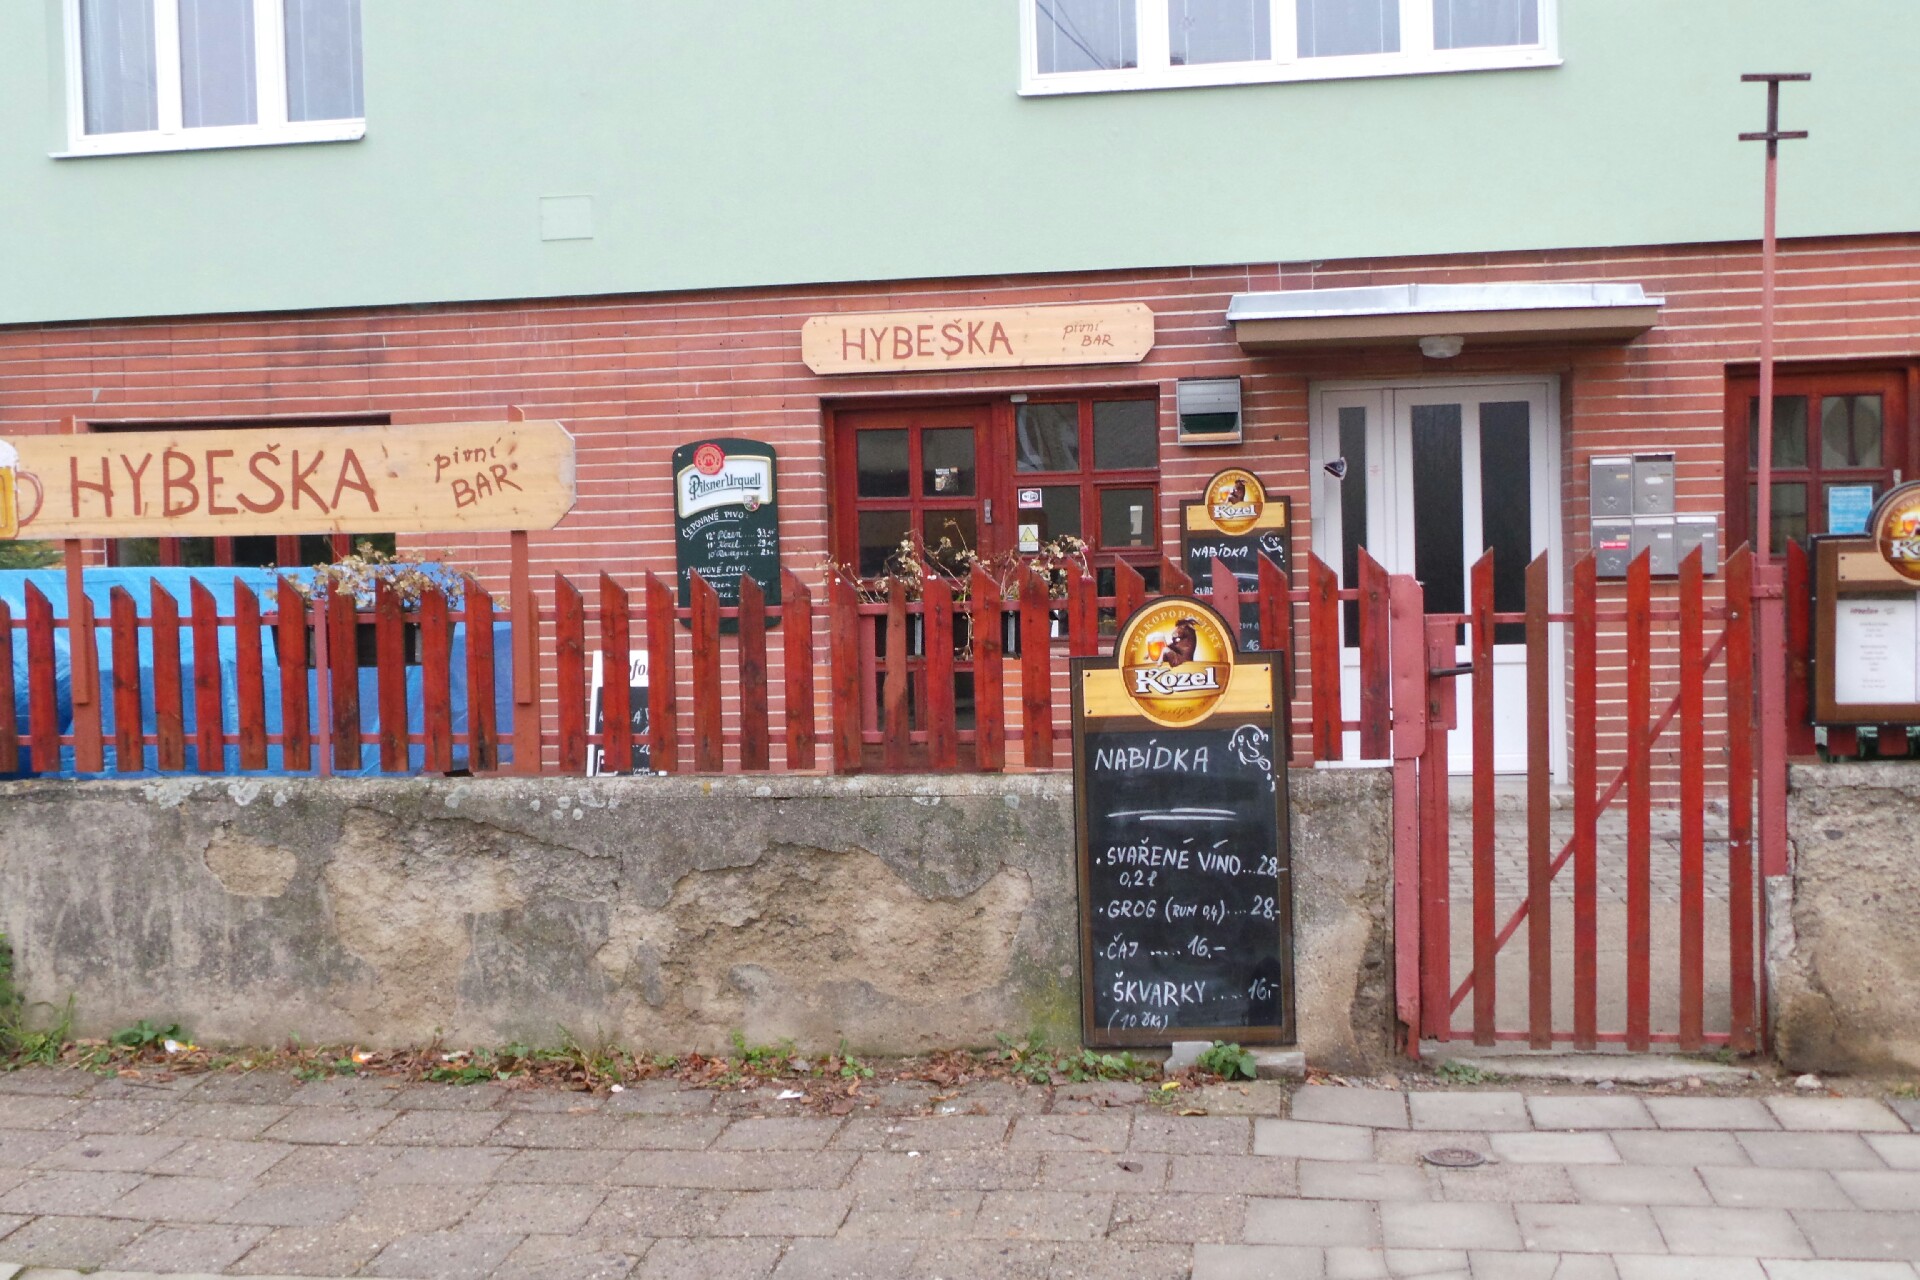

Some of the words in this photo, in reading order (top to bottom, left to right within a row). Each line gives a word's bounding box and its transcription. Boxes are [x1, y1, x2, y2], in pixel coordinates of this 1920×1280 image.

[842, 318, 1015, 361] HYBEŠKA
[1062, 319, 1104, 340] pivní
[1080, 334, 1115, 347] BAR
[433, 437, 502, 483] pivní
[69, 443, 379, 518] HYBEŠKA
[450, 464, 523, 508] BAR
[688, 474, 726, 501] Pilsner
[725, 472, 762, 491] Urquell
[1213, 504, 1258, 519] Kozel
[1192, 543, 1249, 558] NABÍDKA
[1135, 667, 1219, 694] Kozel
[1094, 739, 1209, 773] NABÍDKA
[1107, 837, 1194, 869] SVAŘENÉ
[1107, 900, 1157, 919] GROG
[1165, 896, 1197, 923] (RUM
[1107, 933, 1139, 960] ČAJ
[1113, 971, 1206, 1007] ŠKVARKY
